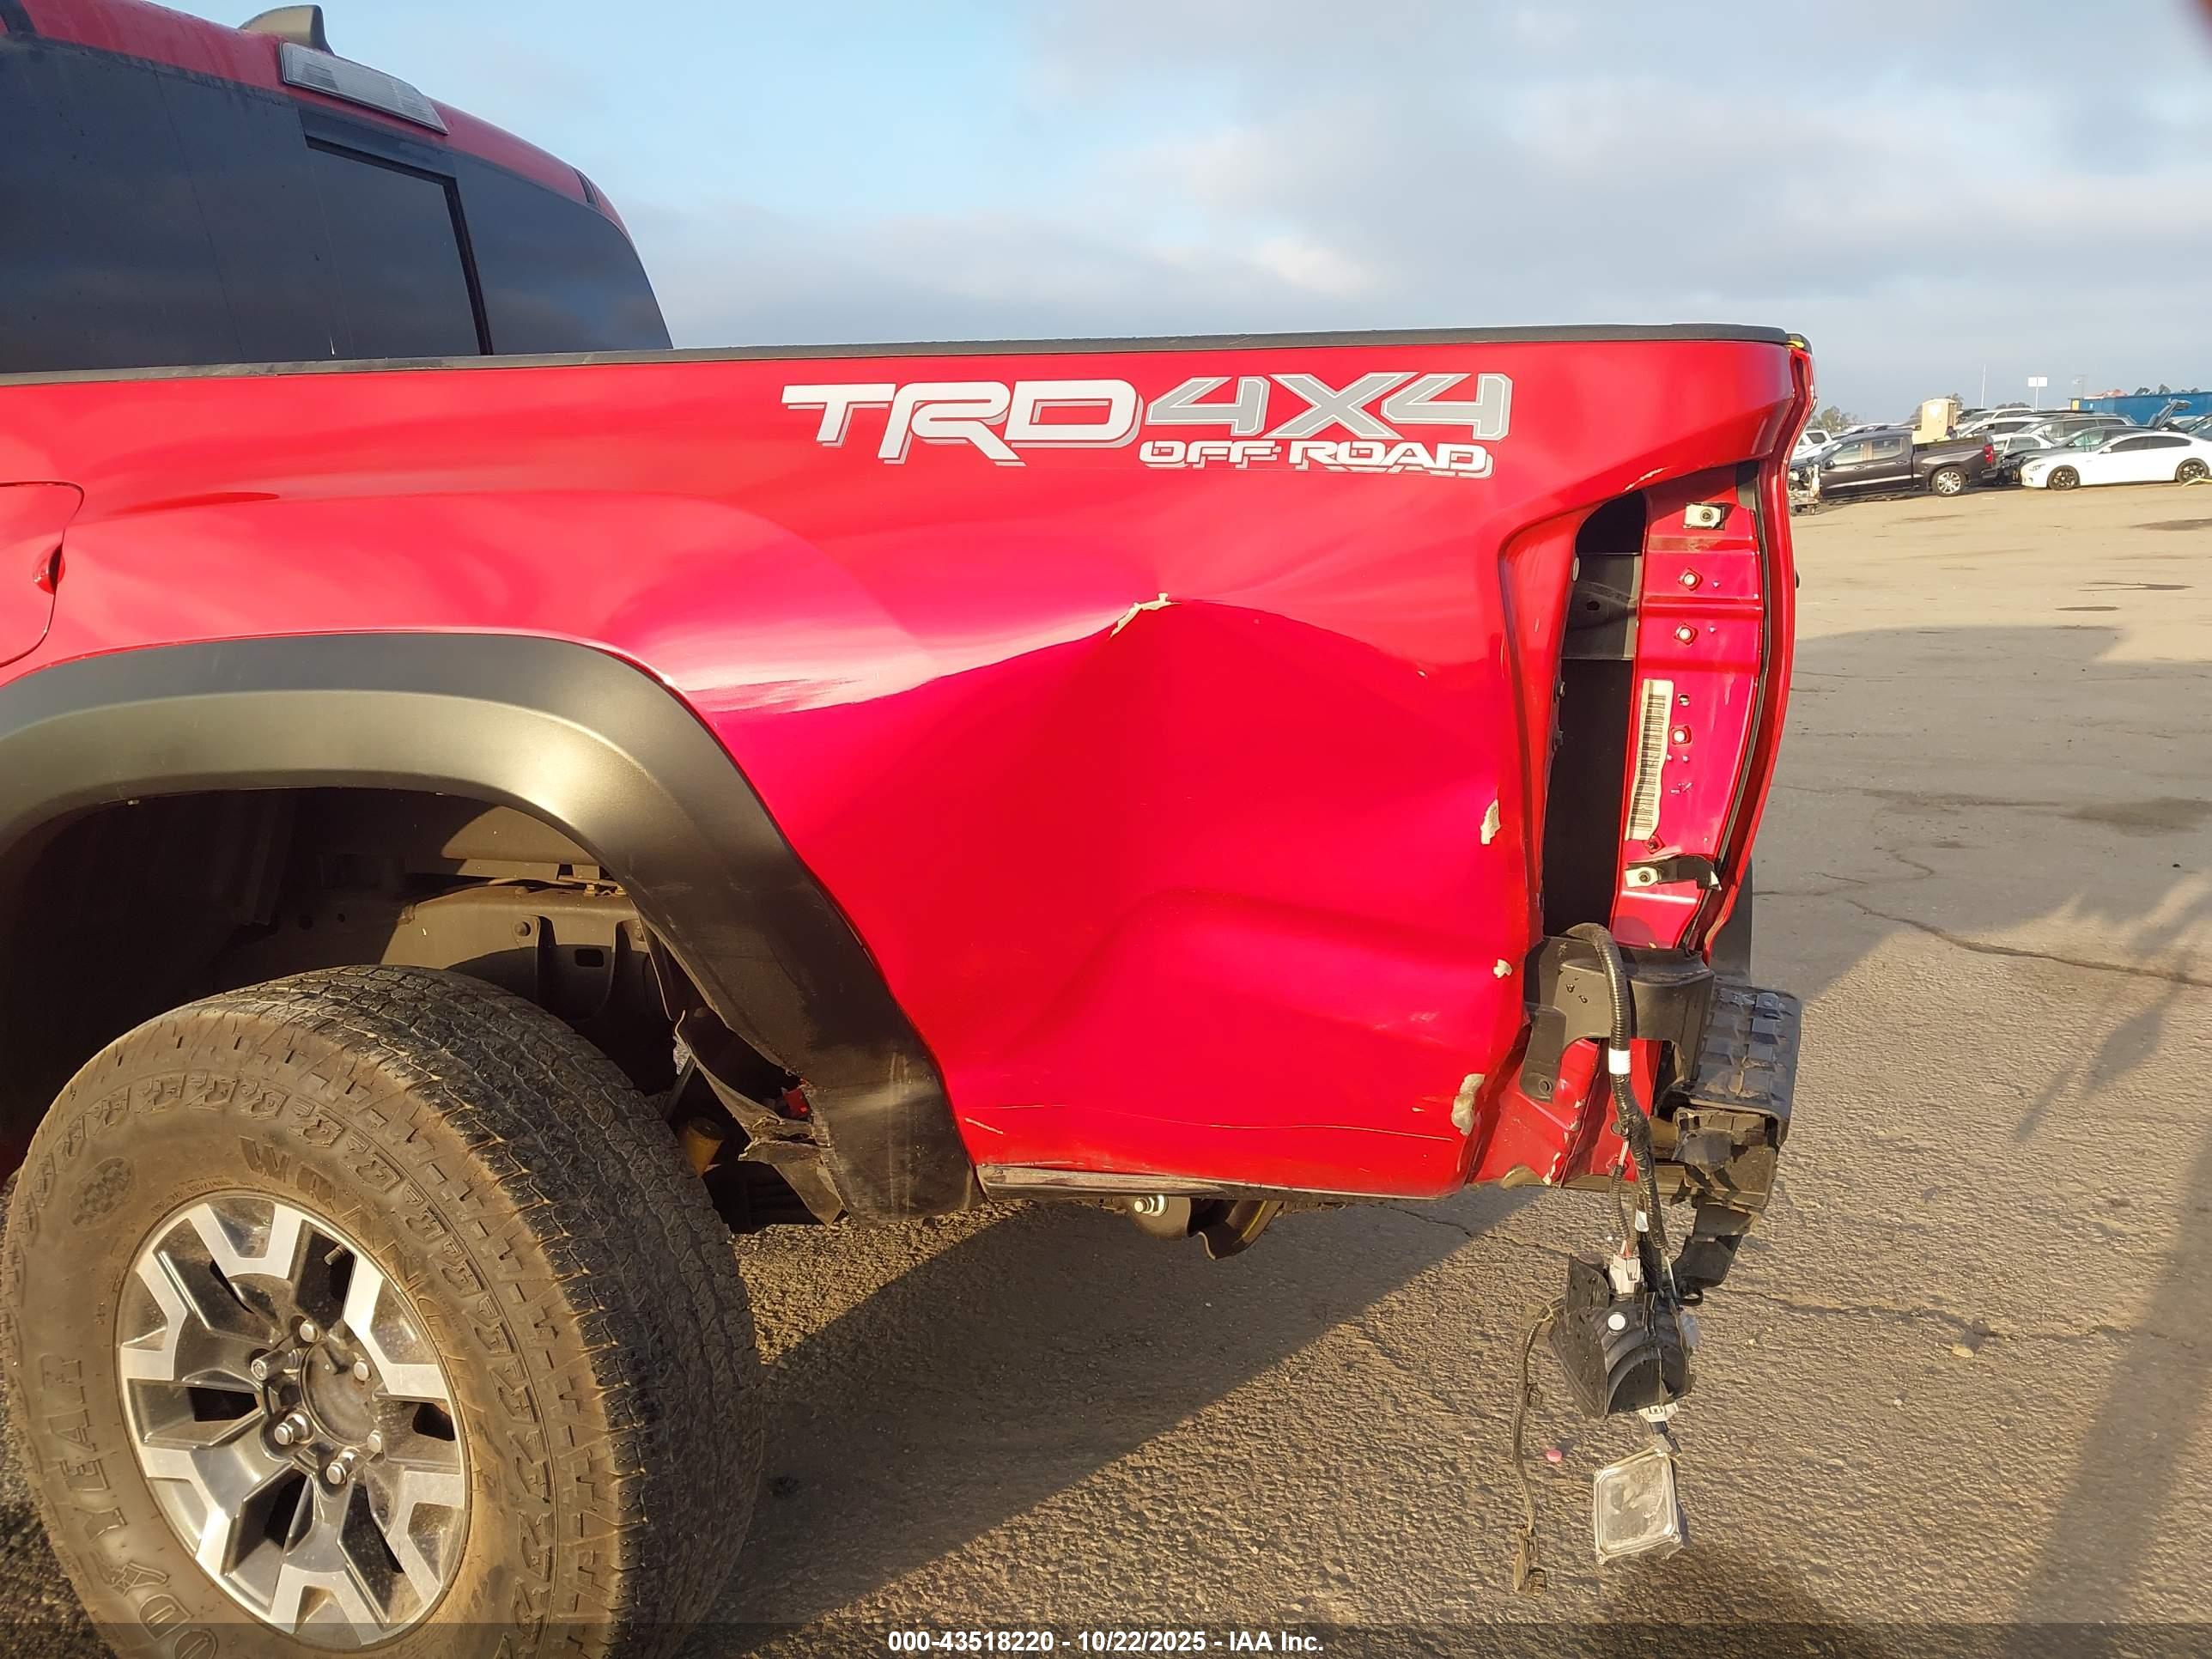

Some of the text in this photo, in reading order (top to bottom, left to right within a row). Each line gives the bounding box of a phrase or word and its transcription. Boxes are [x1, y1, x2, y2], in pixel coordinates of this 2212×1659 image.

[781, 379, 1144, 467] TRD
[1139, 440, 1494, 479] OFF ROAD
